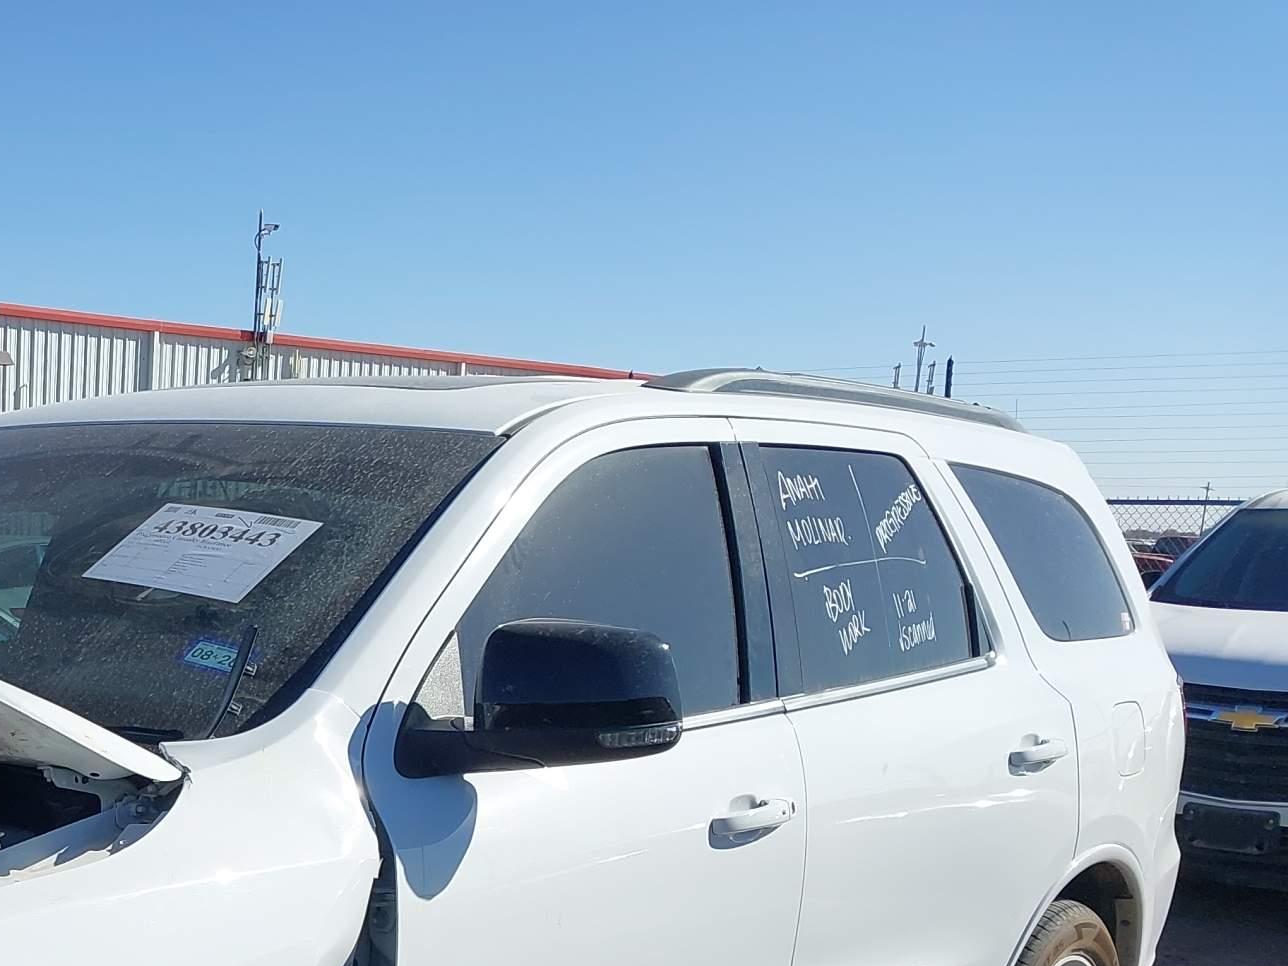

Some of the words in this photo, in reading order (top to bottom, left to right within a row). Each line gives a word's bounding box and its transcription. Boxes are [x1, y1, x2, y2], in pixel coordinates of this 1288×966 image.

[153, 519, 282, 548] 43803443
[823, 578, 856, 623] BODY
[838, 609, 871, 657] WORK
